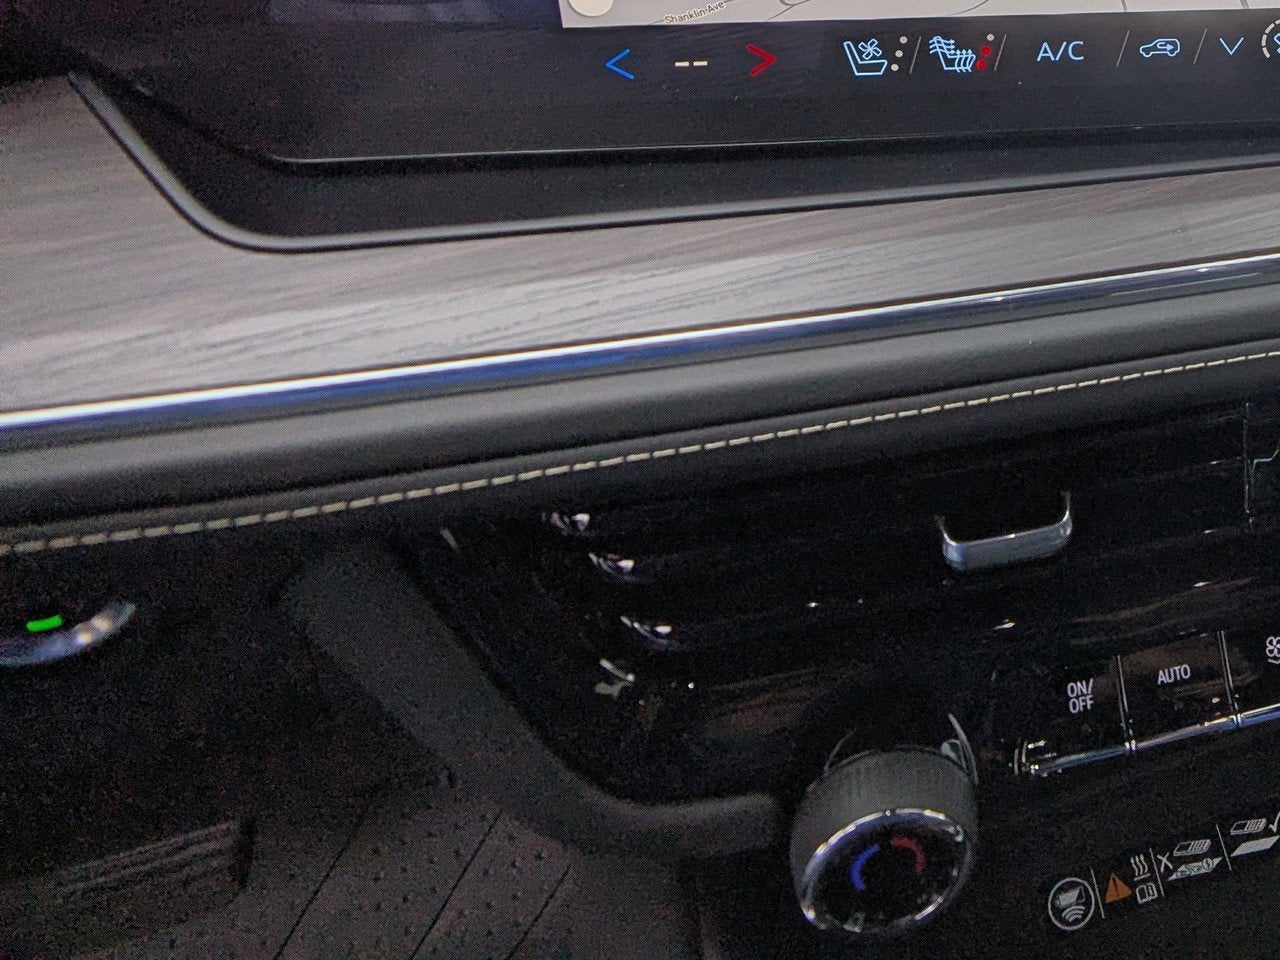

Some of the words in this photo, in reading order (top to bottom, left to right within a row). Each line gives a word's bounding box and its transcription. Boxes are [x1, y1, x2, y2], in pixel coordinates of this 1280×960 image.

[664, 6, 706, 24] Shanklin
[706, 0, 724, 13] Ave
[1037, 40, 1085, 62] A/C
[1156, 663, 1191, 685] AUTO
[1067, 678, 1094, 698] ON/
[1069, 695, 1095, 714] OFF
